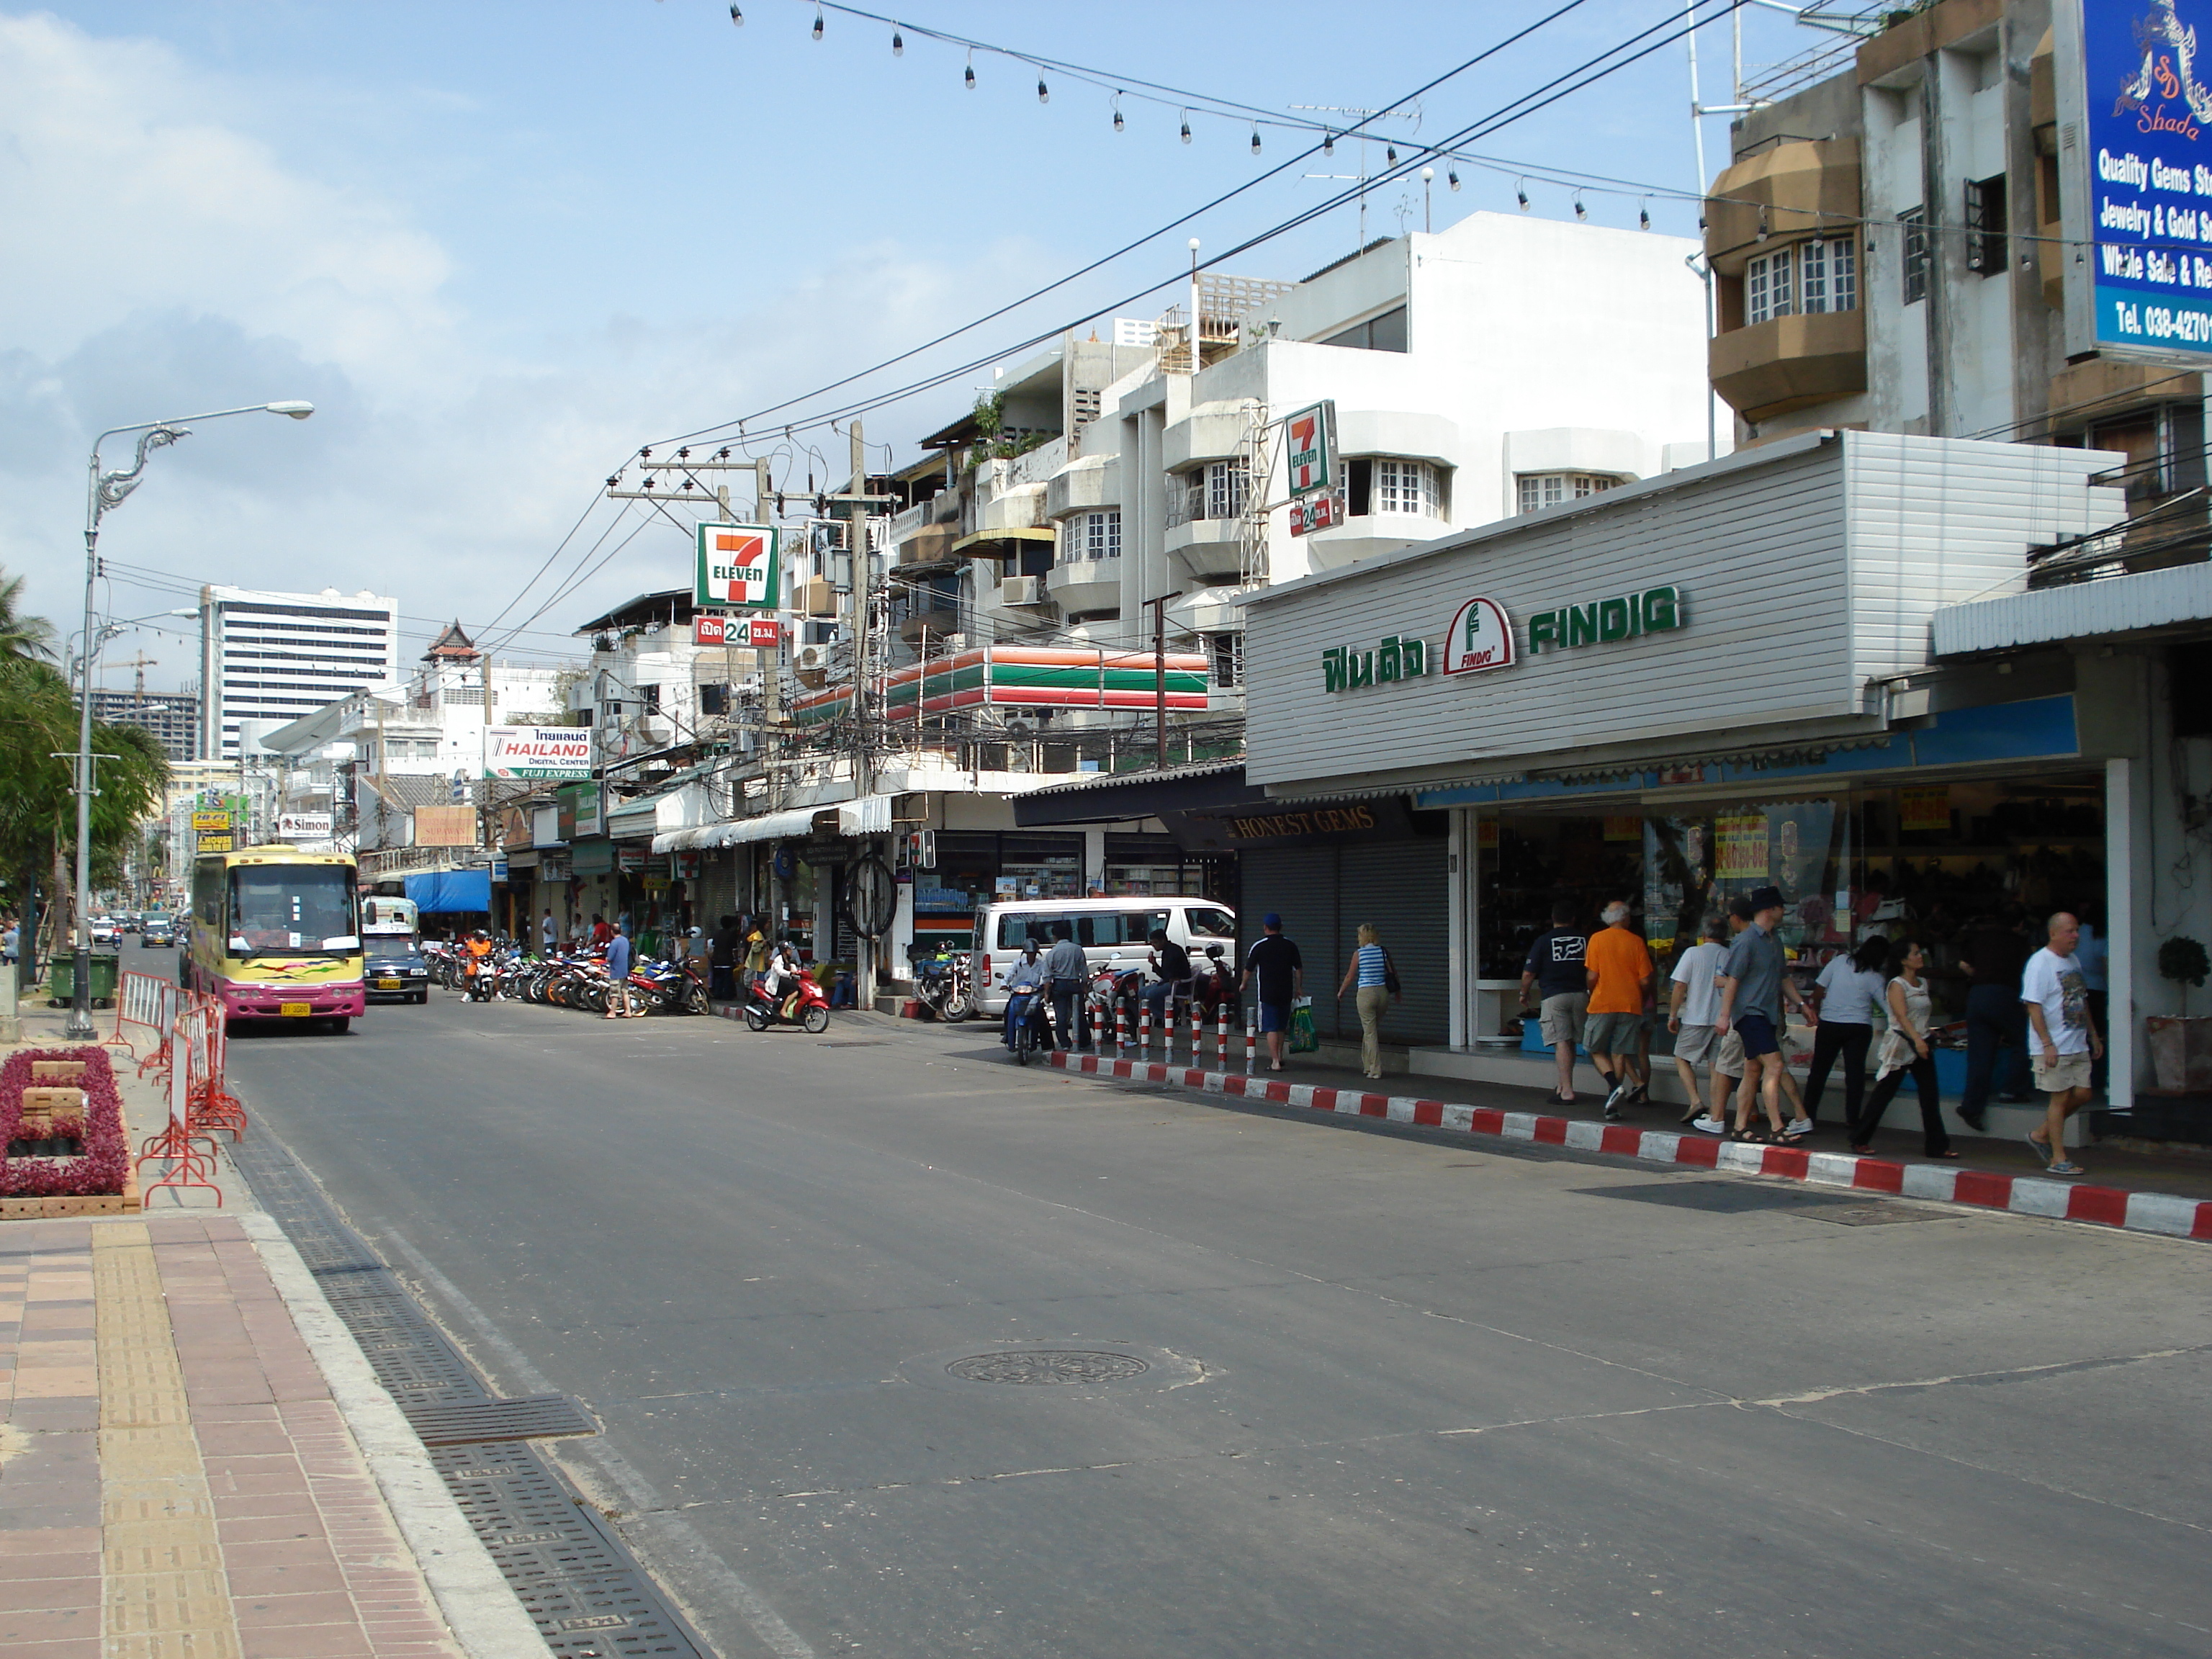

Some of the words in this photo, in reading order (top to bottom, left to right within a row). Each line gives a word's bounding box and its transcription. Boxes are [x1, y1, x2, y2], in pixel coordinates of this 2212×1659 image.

[2136, 104, 2200, 141] Shada
[2098, 148, 2149, 193] Quality
[2151, 156, 2191, 194] Gems
[2100, 195, 2152, 240] Jewelry
[2154, 203, 2165, 236] &
[2167, 206, 2197, 240] Gold
[2180, 254, 2191, 287] &
[2194, 256, 2212, 289] Re
[2116, 300, 2142, 335] Tel.
[1291, 415, 1315, 488] 7
[1303, 506, 1316, 529] 24
[716, 534, 763, 602] 7
[700, 621, 722, 637] เปิด
[725, 623, 750, 642] 24
[1529, 586, 1680, 655] FINDIG
[1461, 649, 1491, 668] FINDIG
[534, 729, 588, 742] ไทยแลนด์
[521, 769, 544, 778] FUJI
[546, 769, 589, 778] EXPRESS
[294, 818, 330, 831] Simon
[1234, 814, 1313, 839] HONEST
[1313, 805, 1375, 833] GEMS
[421, 836, 473, 845] GOLDSMITH
[680, 853, 698, 878] 7
